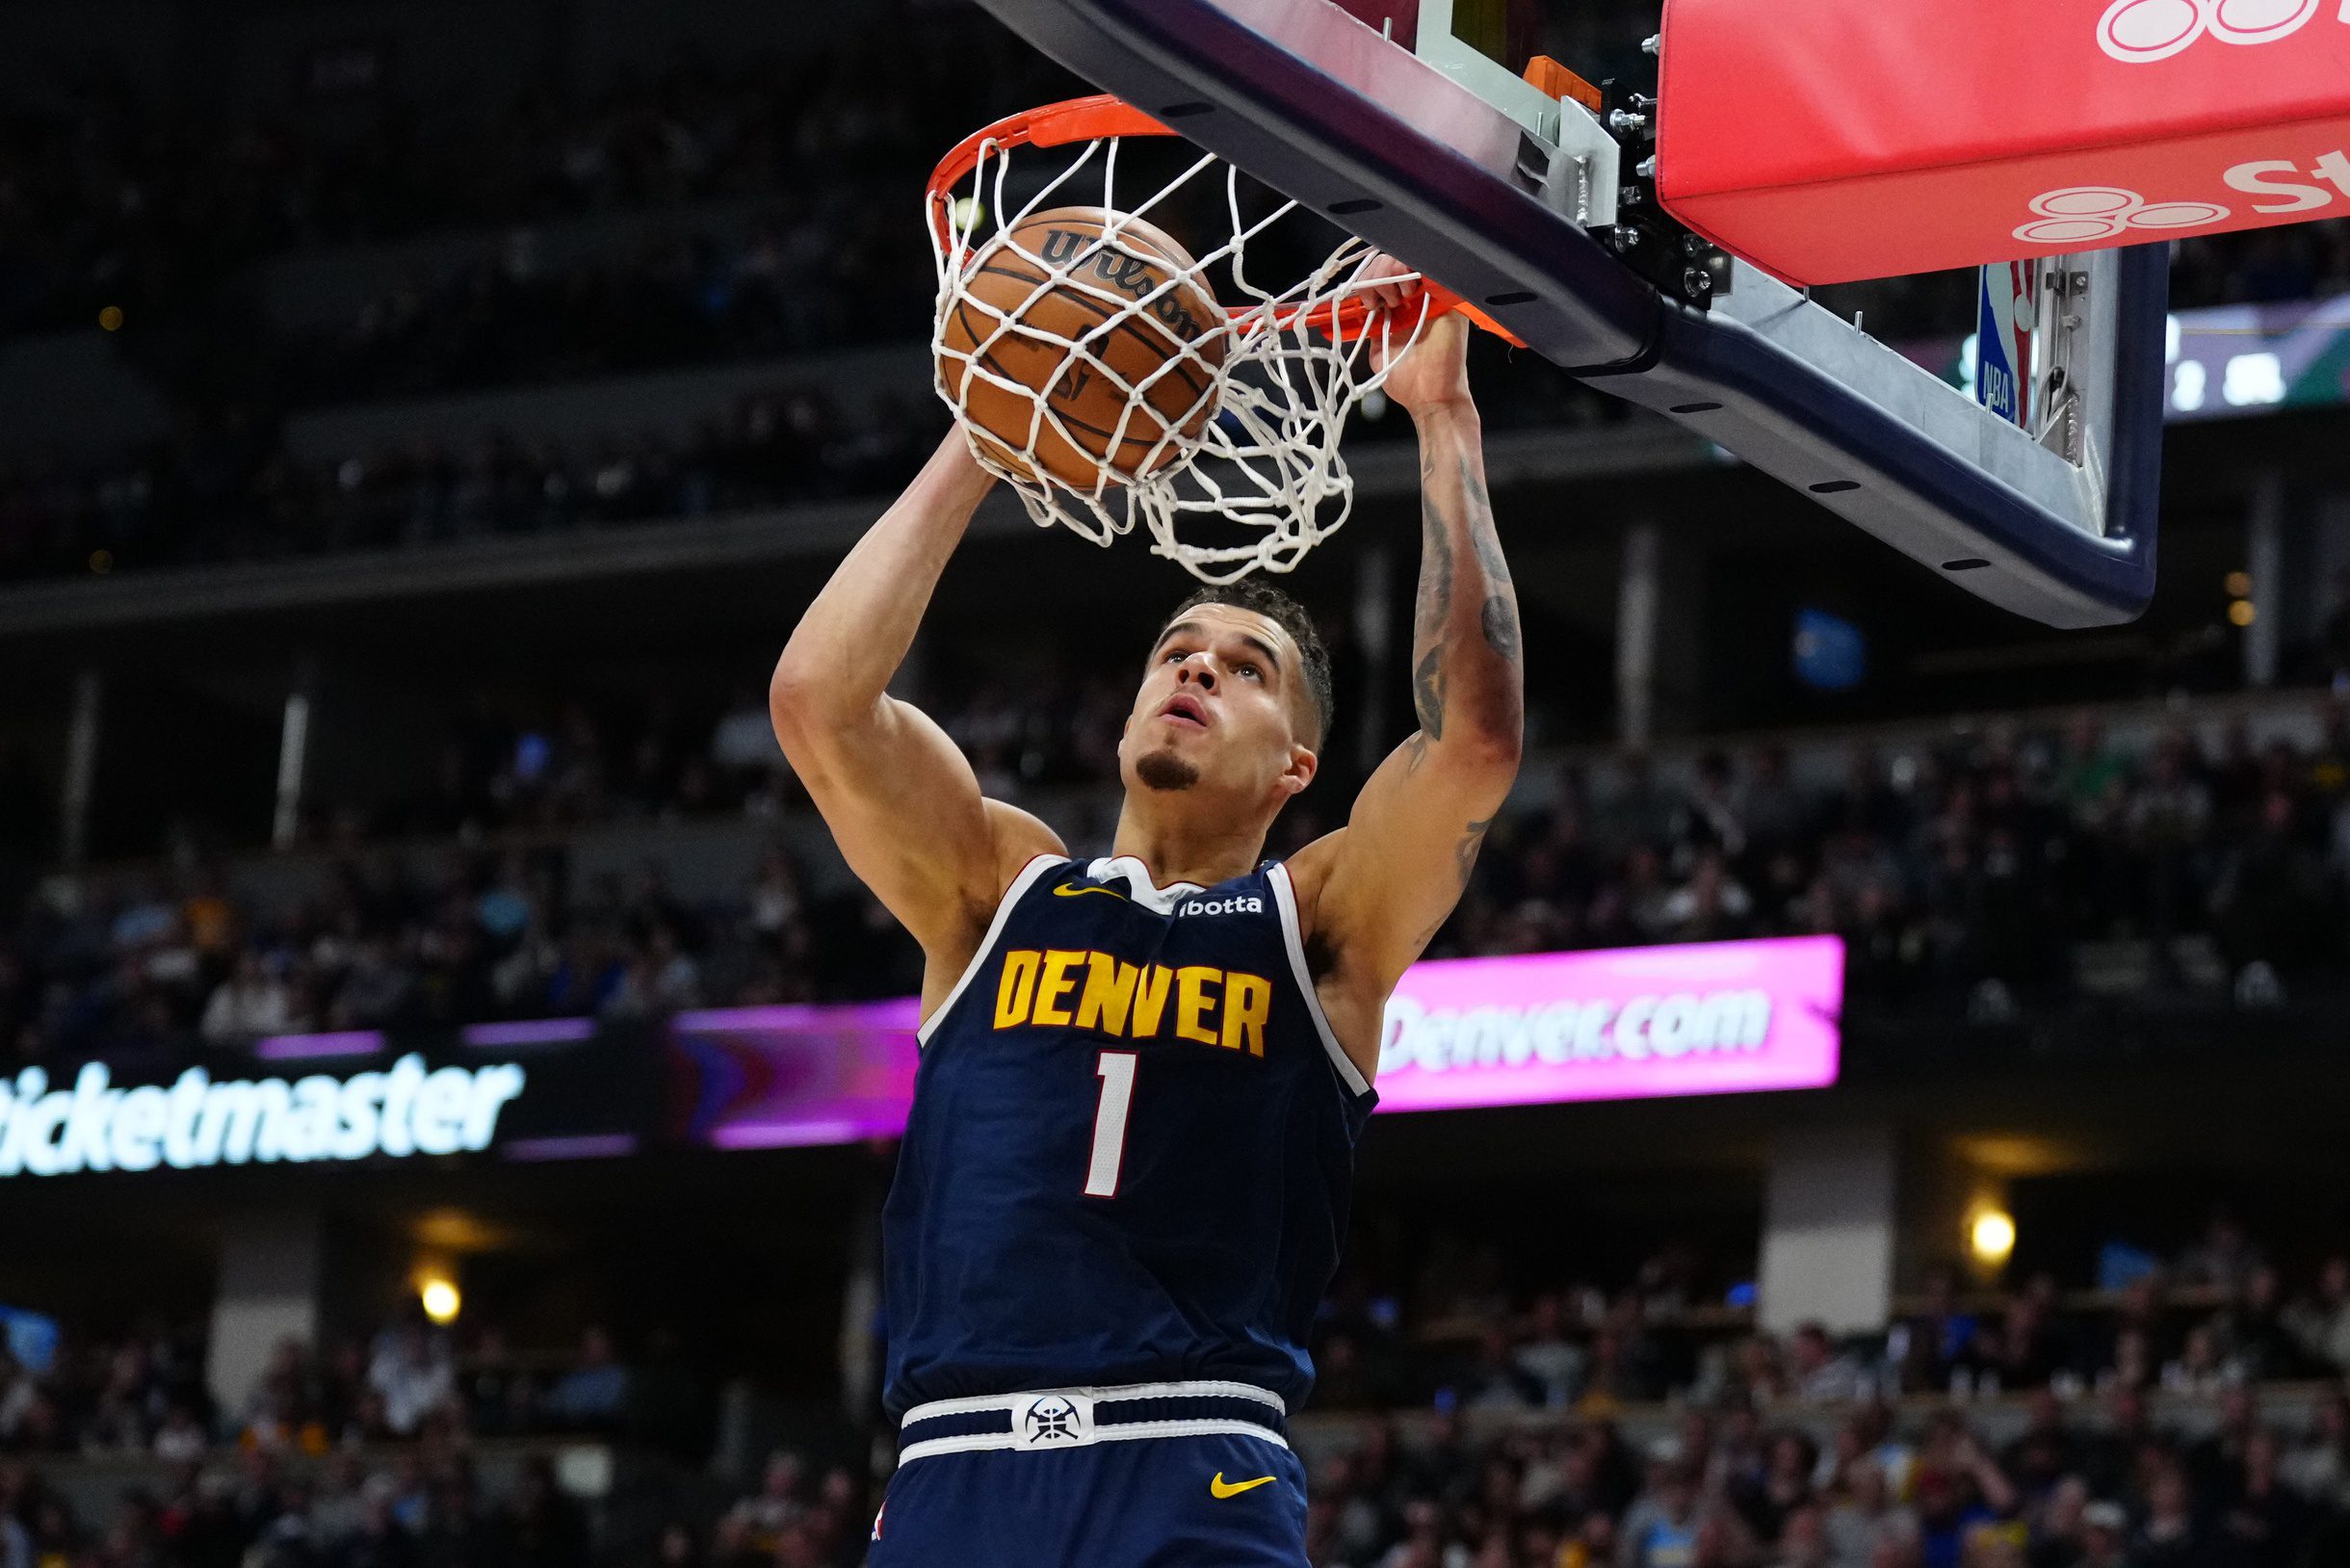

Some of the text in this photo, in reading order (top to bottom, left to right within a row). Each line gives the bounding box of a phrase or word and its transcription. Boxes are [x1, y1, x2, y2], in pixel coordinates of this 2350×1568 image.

[1983, 360, 2009, 413] NBA
[1179, 896, 1262, 918] ibotta
[993, 949, 1271, 1058] DENVER
[1084, 1050, 1138, 1198] 1
